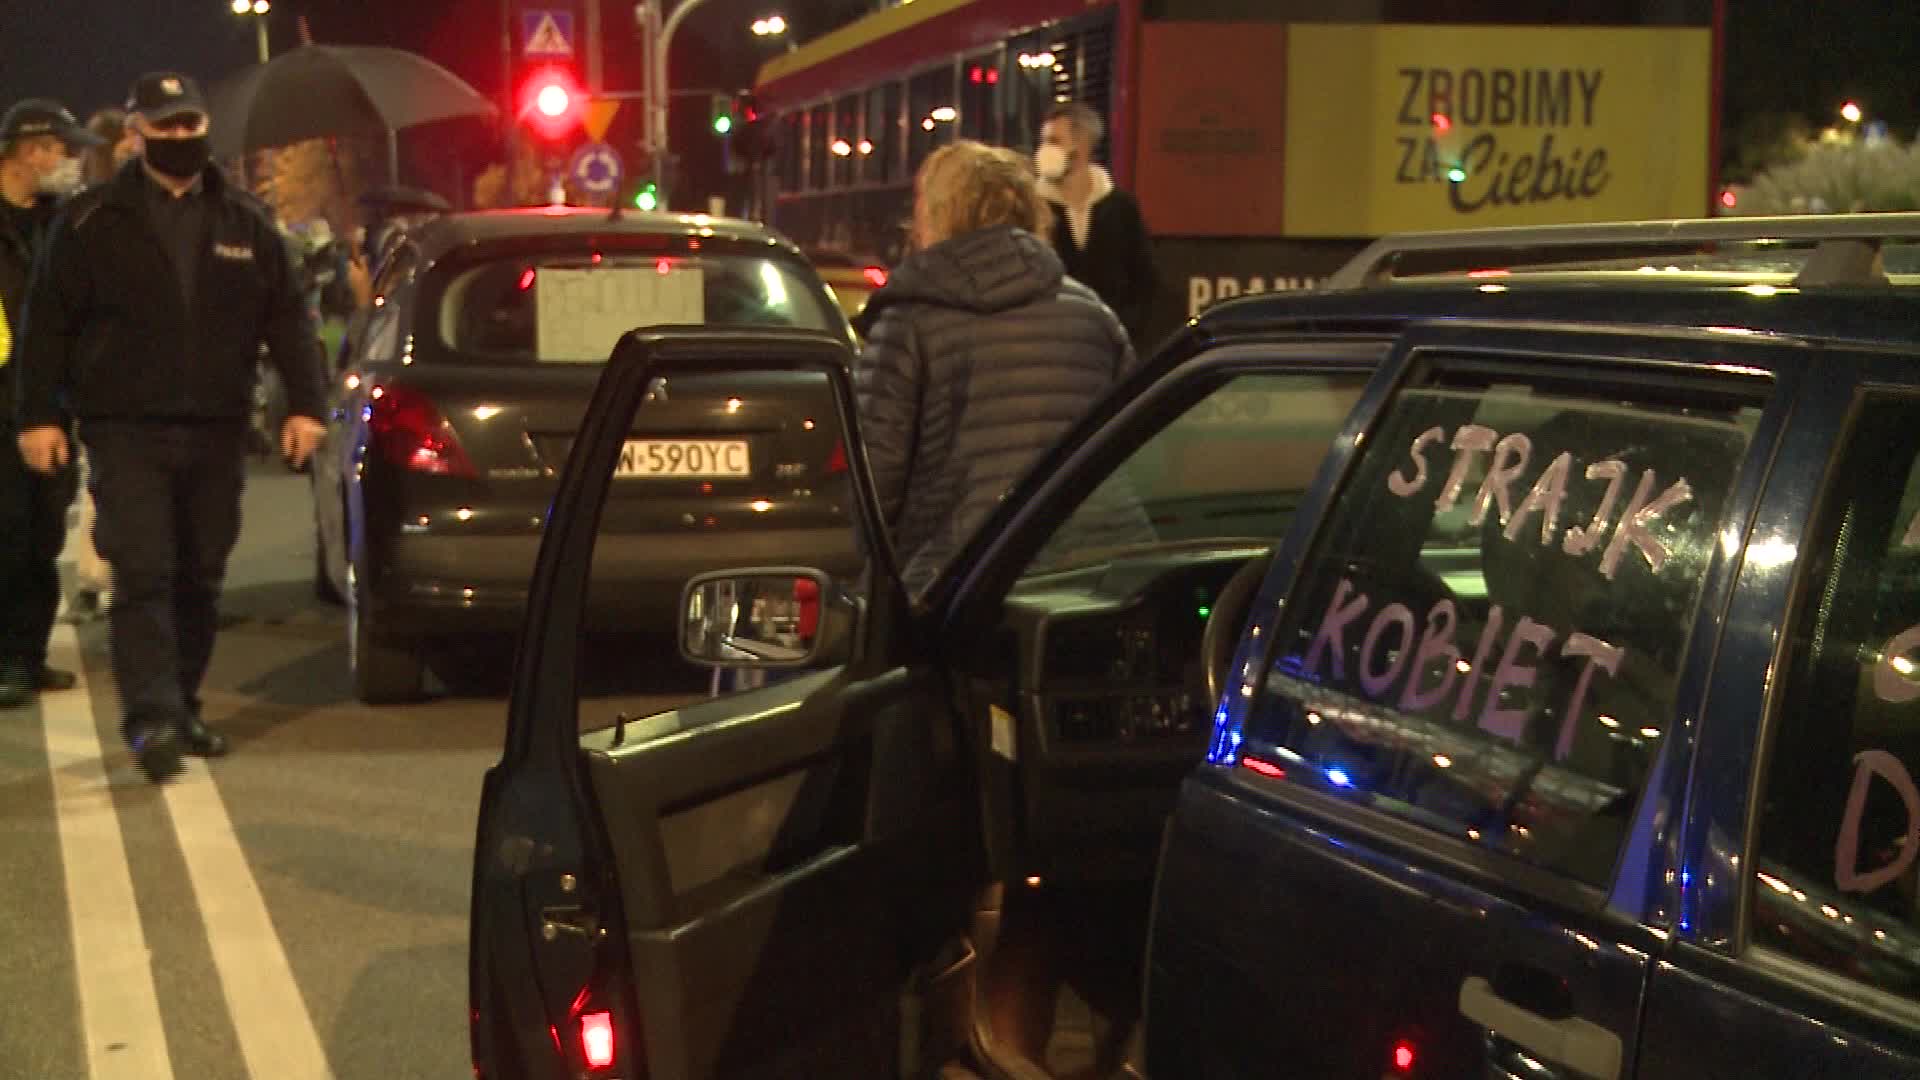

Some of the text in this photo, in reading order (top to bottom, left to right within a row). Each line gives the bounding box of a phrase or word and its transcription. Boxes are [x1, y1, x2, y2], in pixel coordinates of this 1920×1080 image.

[1396, 67, 1603, 127] ZROBIMY
[1395, 132, 1611, 212] ZA Ciebie
[1388, 425, 1692, 579] STRAJK
[1303, 579, 1625, 760] KOBIET
